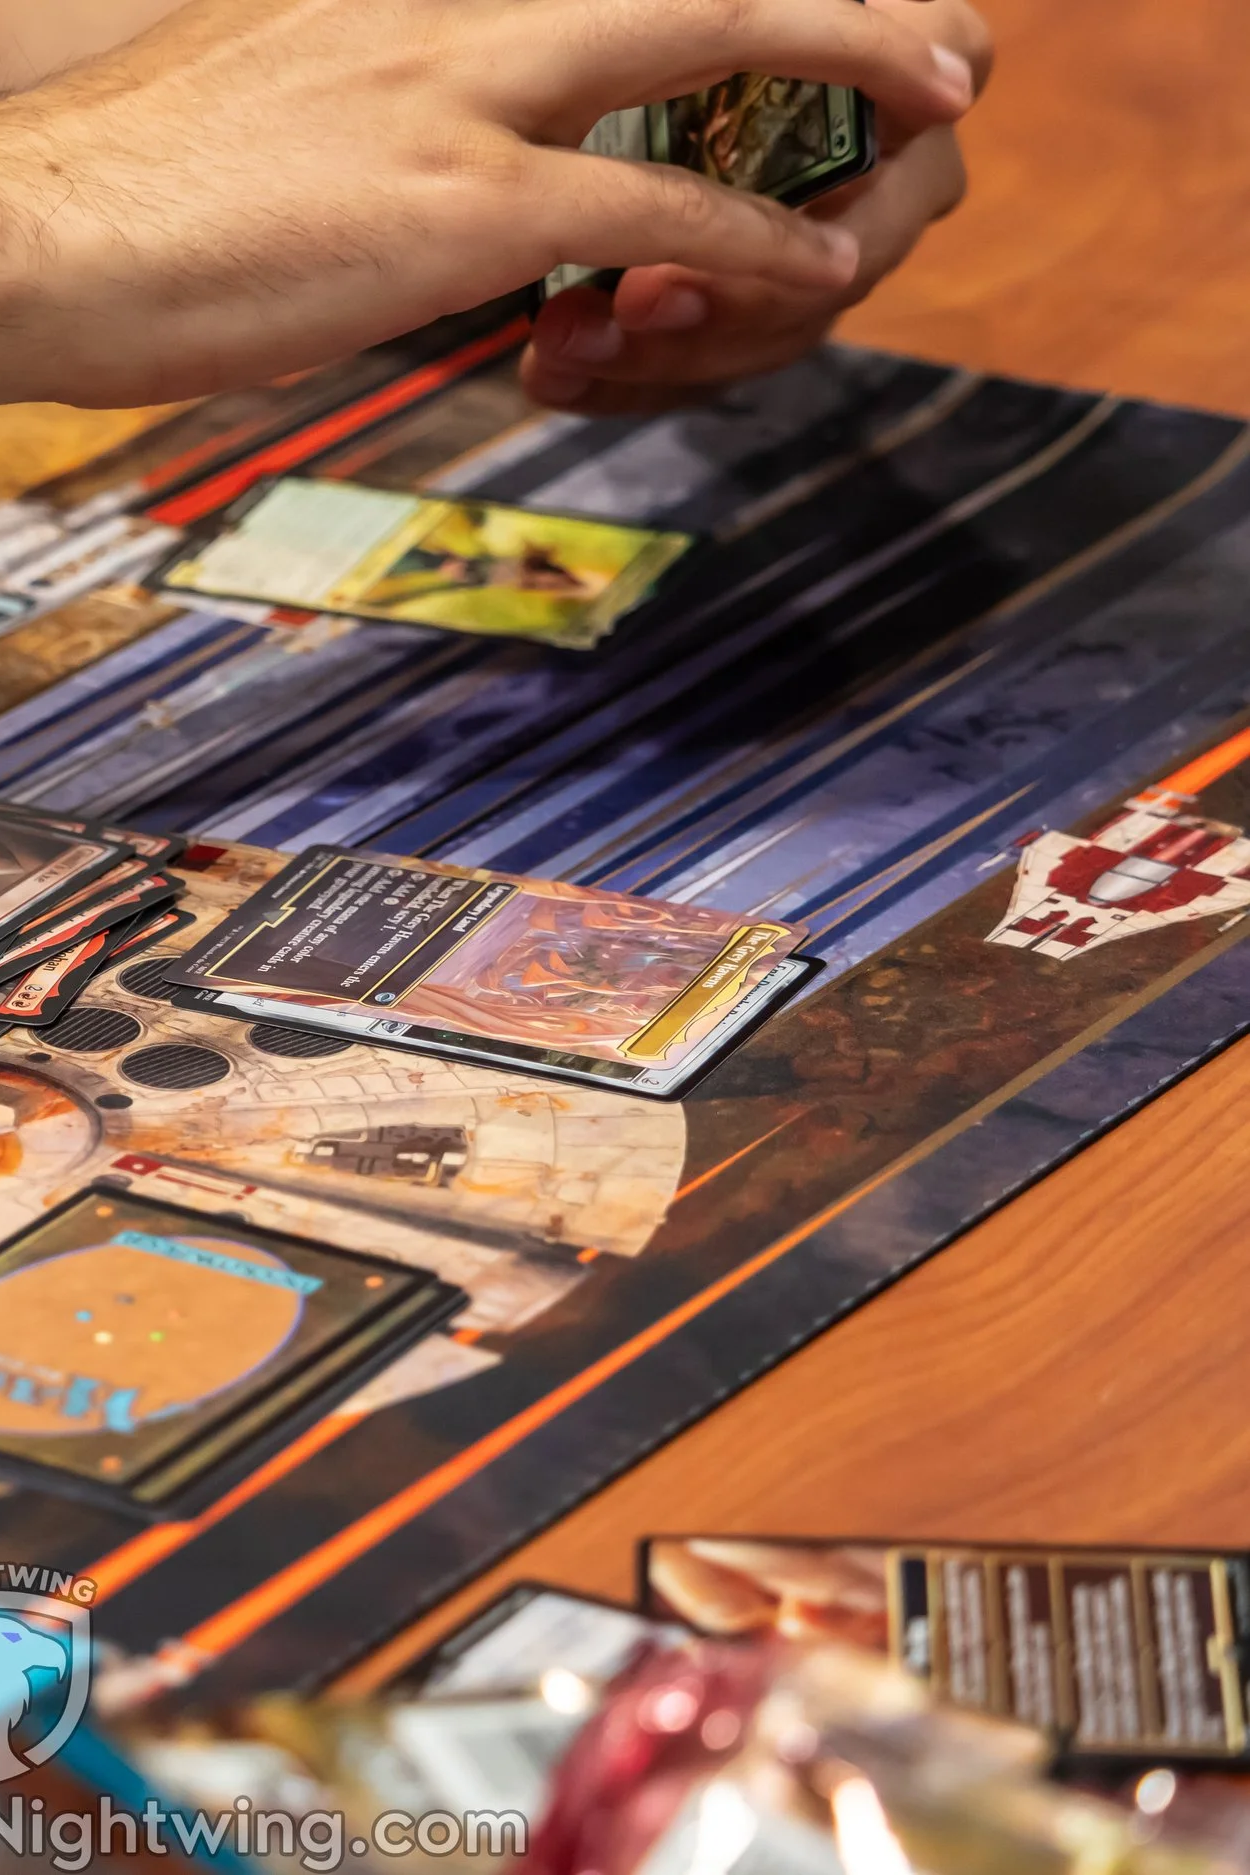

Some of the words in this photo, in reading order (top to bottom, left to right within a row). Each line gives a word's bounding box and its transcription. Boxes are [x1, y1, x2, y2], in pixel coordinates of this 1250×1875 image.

[366, 877, 395, 893] Add
[390, 881, 418, 897] Add
[312, 886, 364, 920] legendary
[351, 891, 375, 906] one
[420, 898, 449, 913] The
[464, 883, 512, 916] Legendary
[331, 905, 360, 924] mana
[383, 909, 410, 924] scry
[398, 911, 433, 931] Grey
[286, 918, 324, 946] creature
[321, 924, 343, 934] of
[449, 915, 479, 932] Land
[305, 932, 330, 945] any
[374, 929, 414, 955] Havens
[743, 930, 773, 946] The
[265, 945, 297, 965] cards
[287, 945, 319, 963] color
[723, 944, 757, 963] Grey
[256, 964, 276, 973] in
[352, 954, 383, 975] enters
[338, 975, 363, 988] the
[698, 962, 739, 989] Havens
